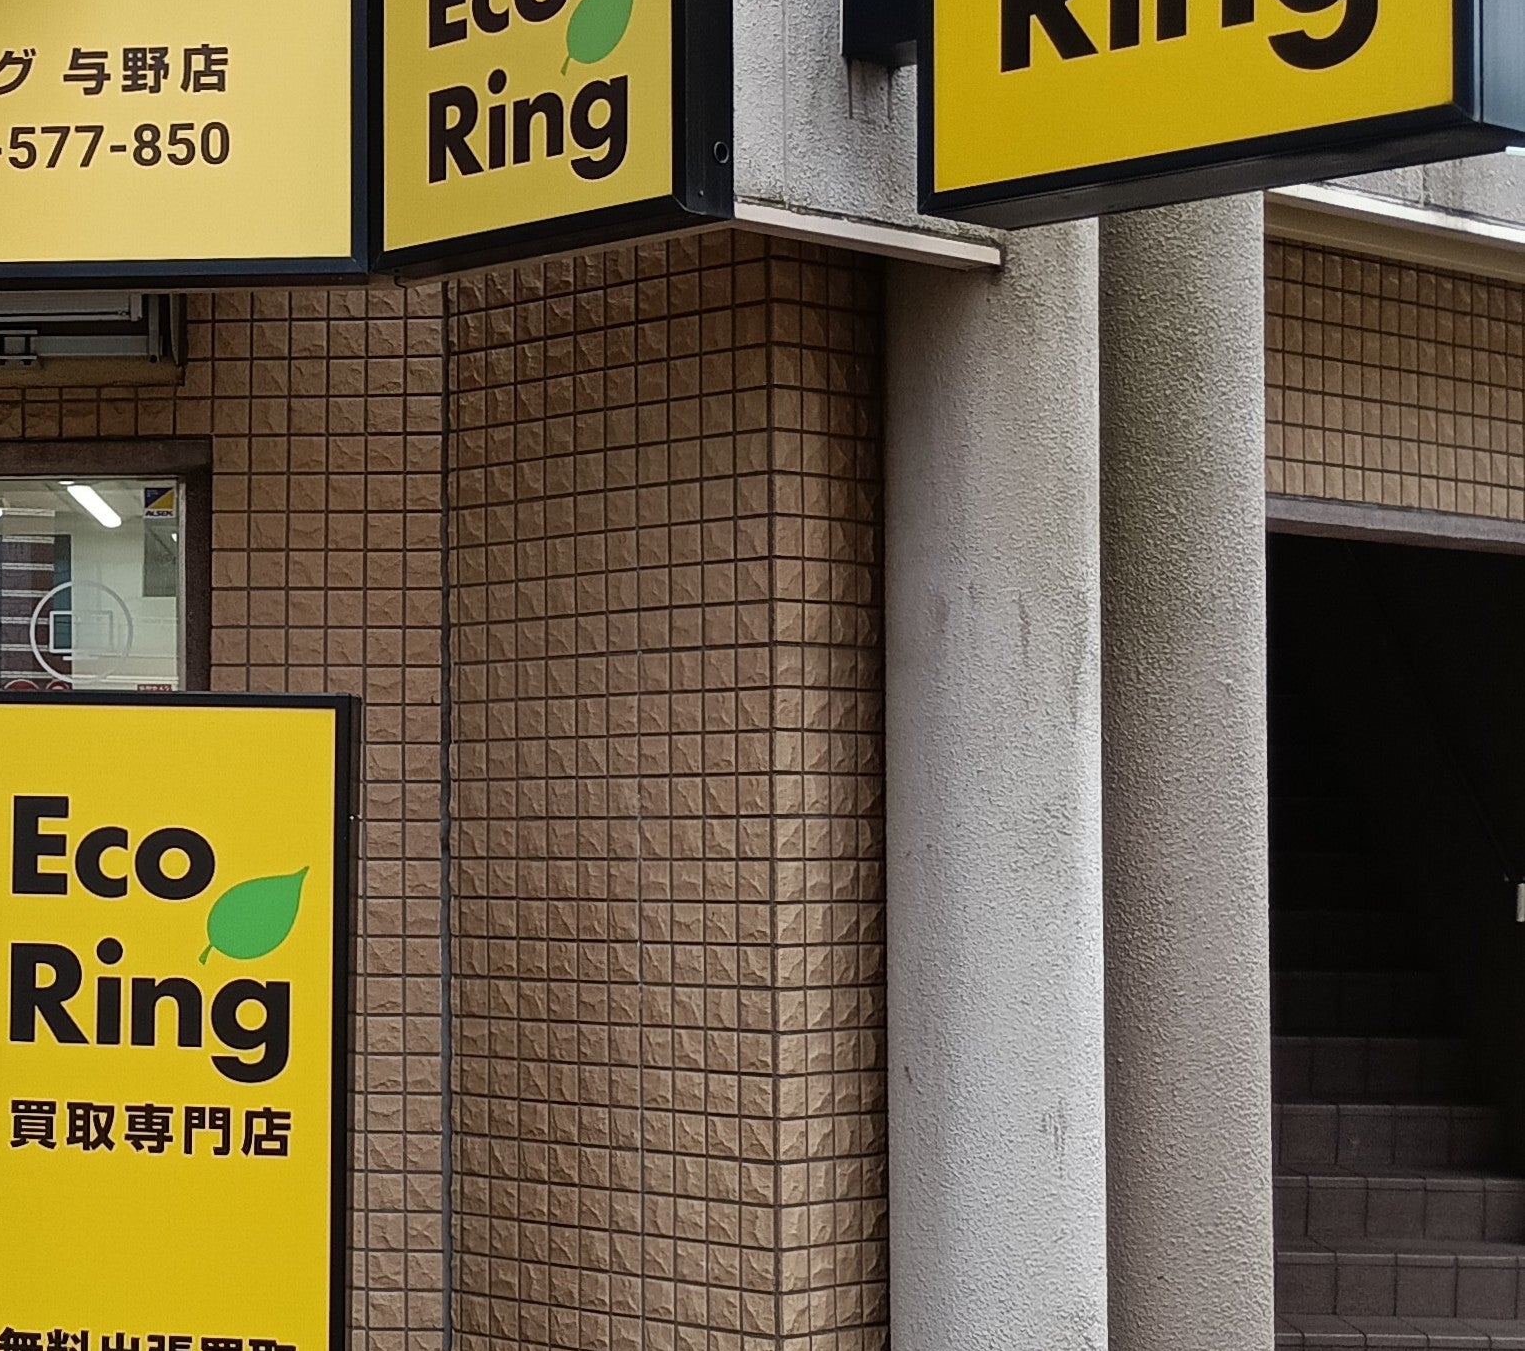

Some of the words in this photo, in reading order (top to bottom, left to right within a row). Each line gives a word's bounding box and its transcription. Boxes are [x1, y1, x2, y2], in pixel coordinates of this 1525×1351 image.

[62, 44, 230, 95] 与野店
[427, 69, 630, 185] Ring
[12, 796, 215, 900] Eco
[10, 937, 290, 1083] Ring
[10, 1100, 291, 1157] 買取専門店
